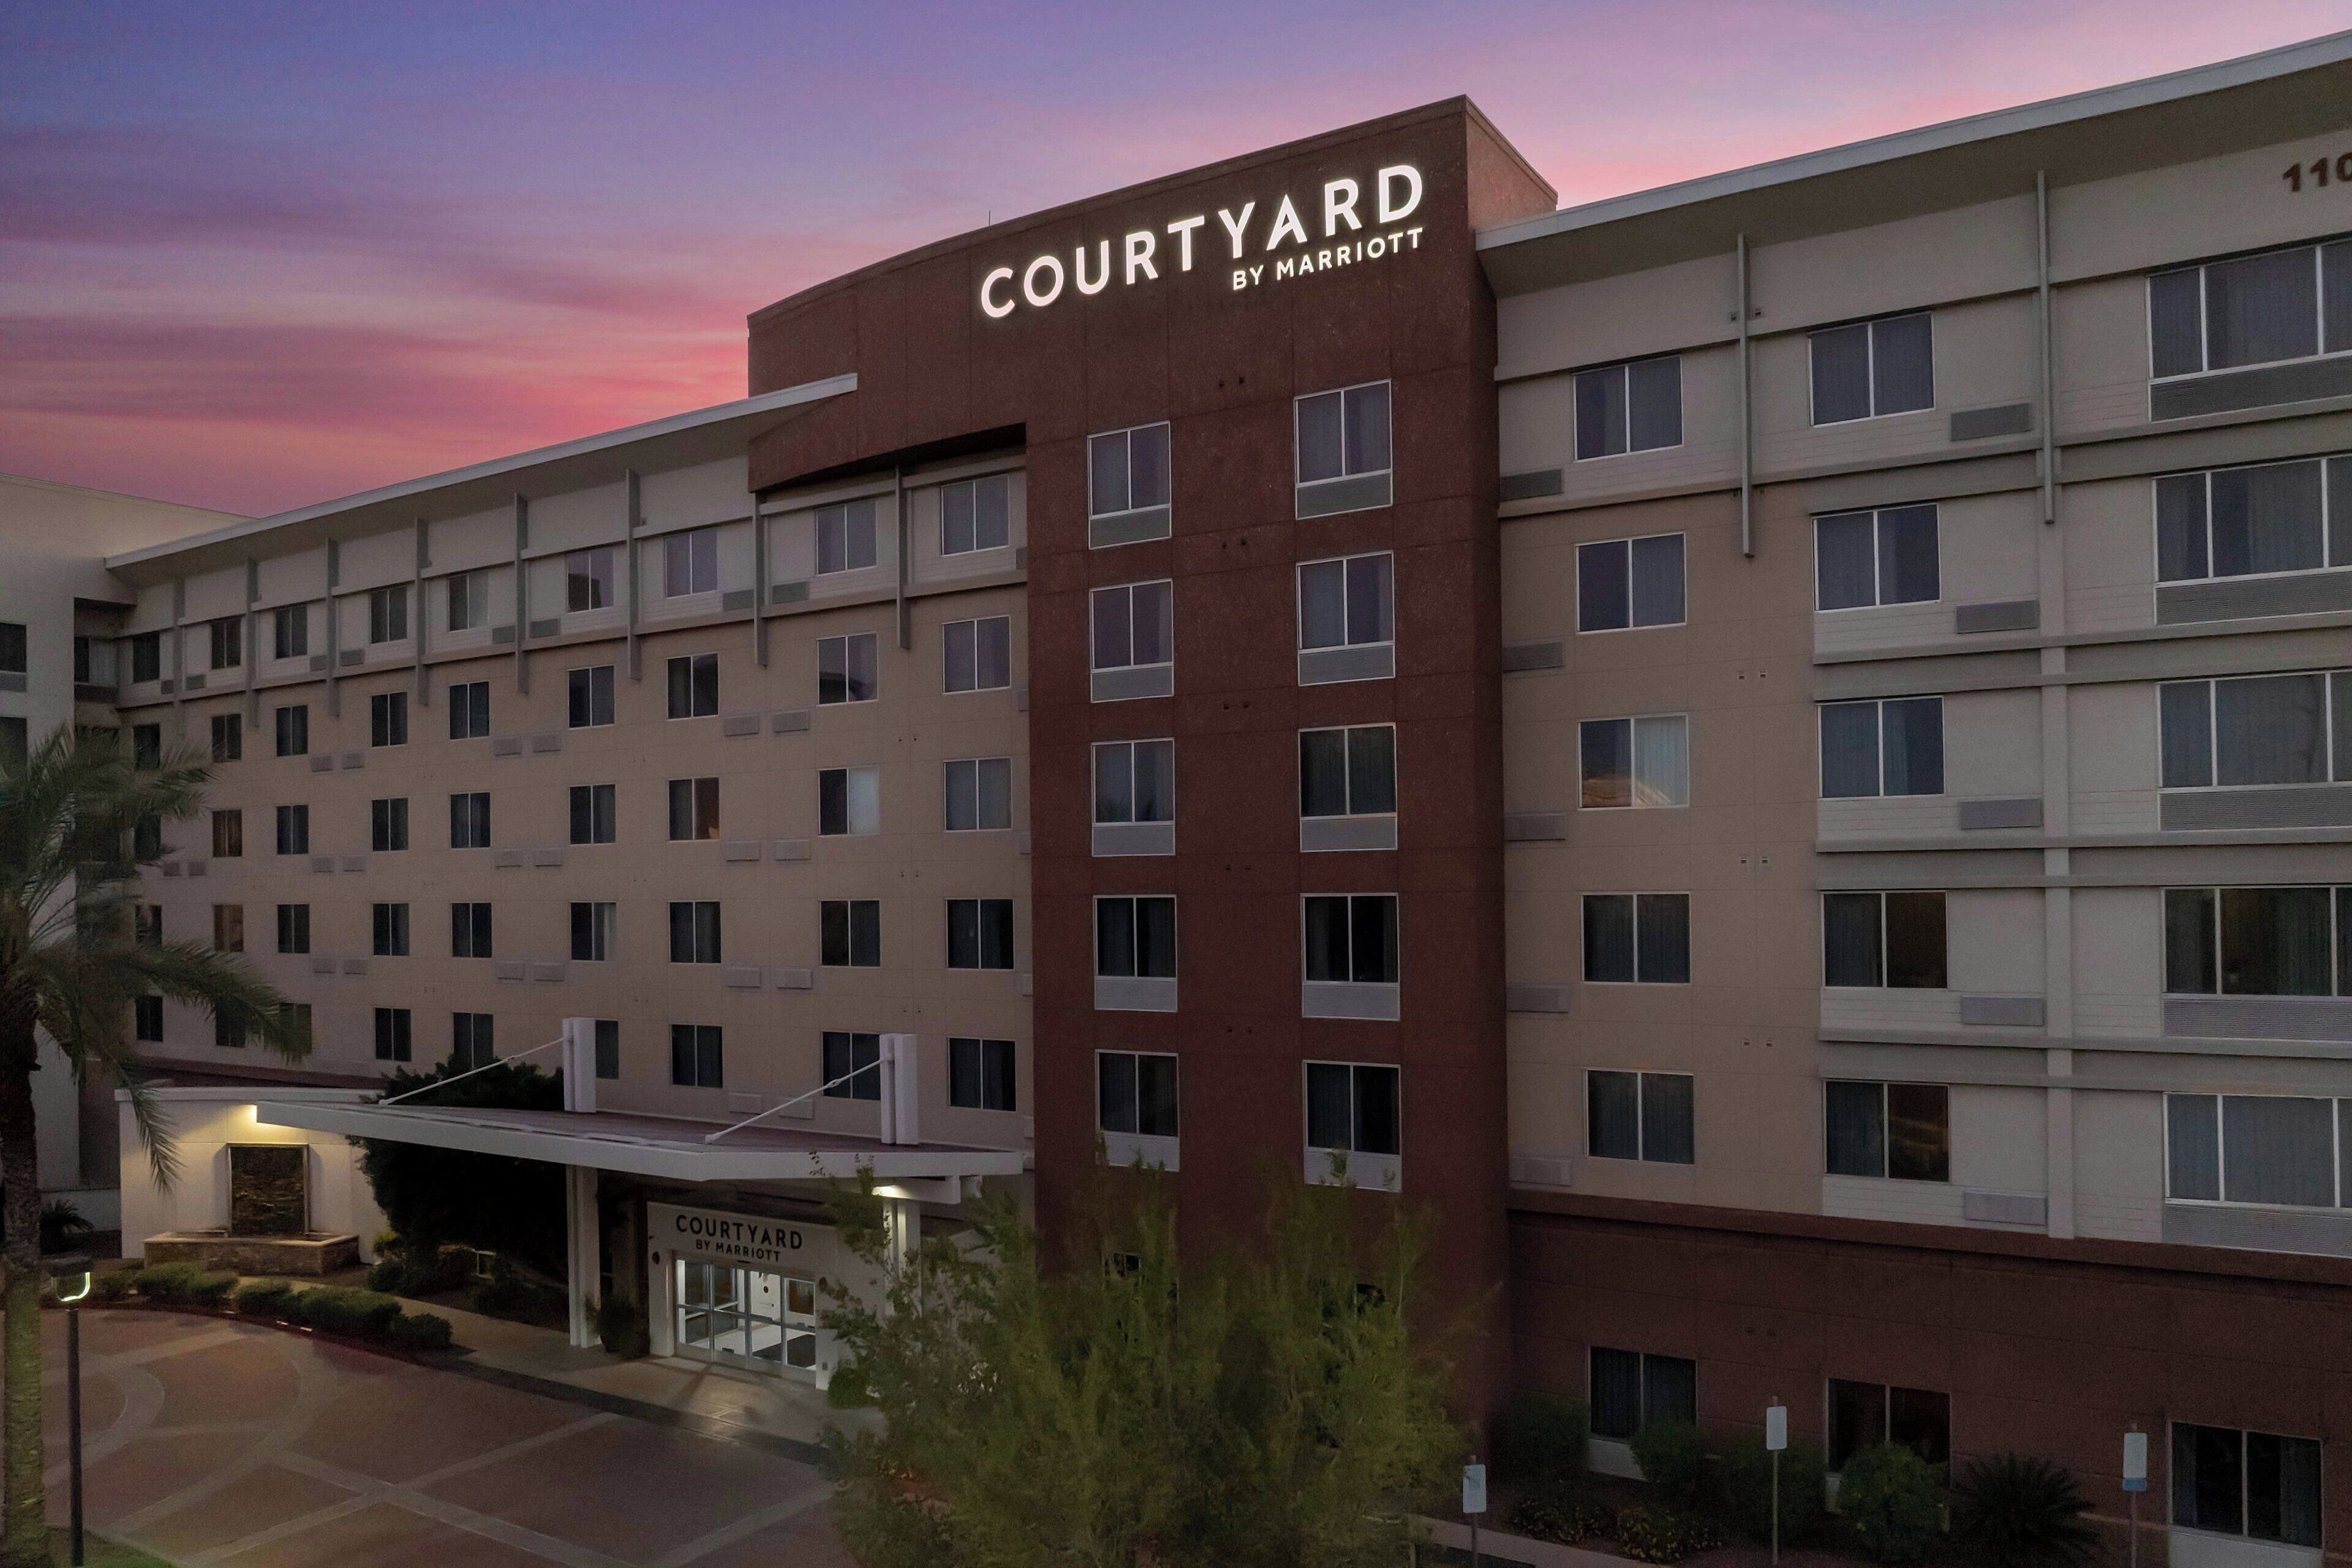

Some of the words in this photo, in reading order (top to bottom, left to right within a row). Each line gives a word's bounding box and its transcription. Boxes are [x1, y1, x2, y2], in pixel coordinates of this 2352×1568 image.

[981, 165, 1423, 318] COURTYARD
[1233, 265, 1264, 291] BY
[1276, 227, 1423, 281] MARRIOTT
[676, 1213, 803, 1250] COURTYARD
[695, 1238, 710, 1251] BY
[715, 1242, 781, 1262] MARRIOTT
